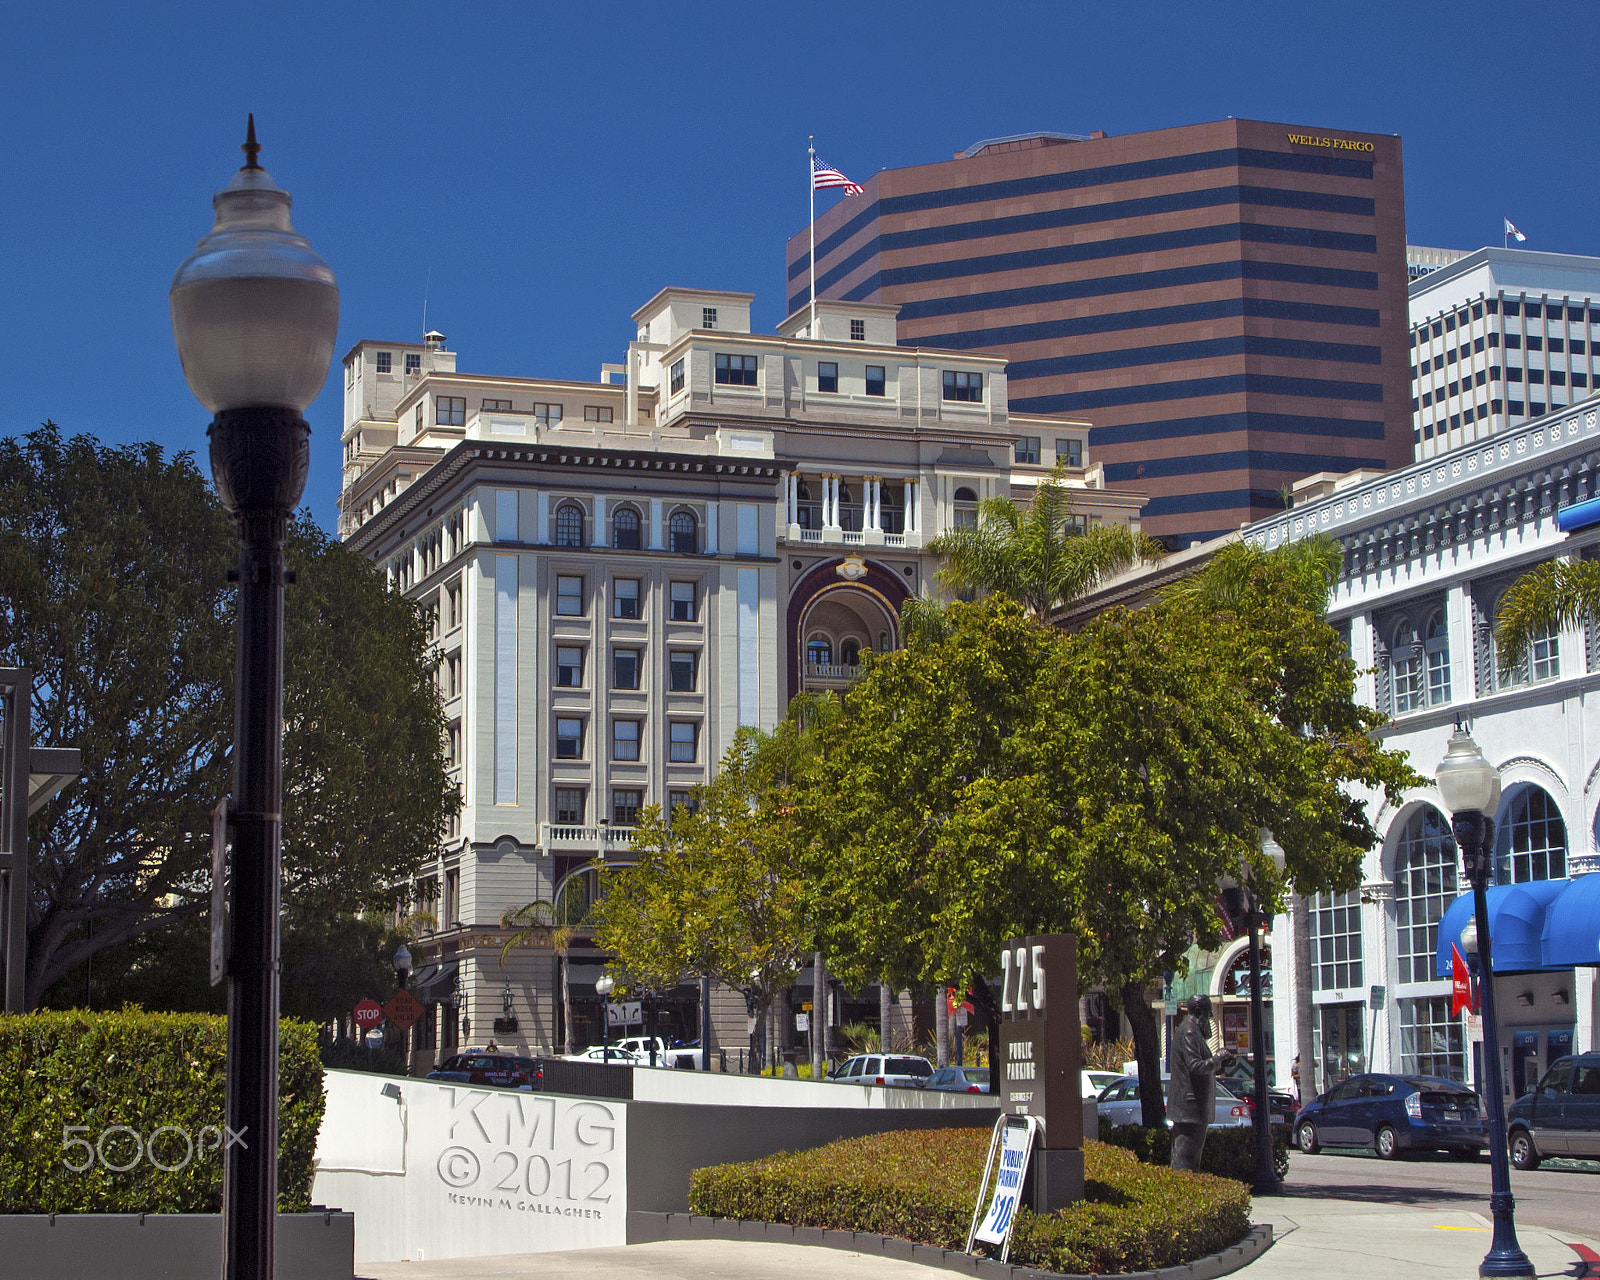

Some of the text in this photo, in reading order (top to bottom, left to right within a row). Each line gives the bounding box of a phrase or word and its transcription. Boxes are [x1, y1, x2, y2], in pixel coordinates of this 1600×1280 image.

[1287, 133, 1374, 152] WELLS FARGO
[1002, 945, 1046, 1012] 225
[357, 1009, 379, 1020] STOP
[1008, 1041, 1033, 1060] PUBLIC
[1006, 1062, 1036, 1080] PARKING
[998, 1169, 1020, 1189] PARKIN
[991, 1193, 1015, 1234] $10
